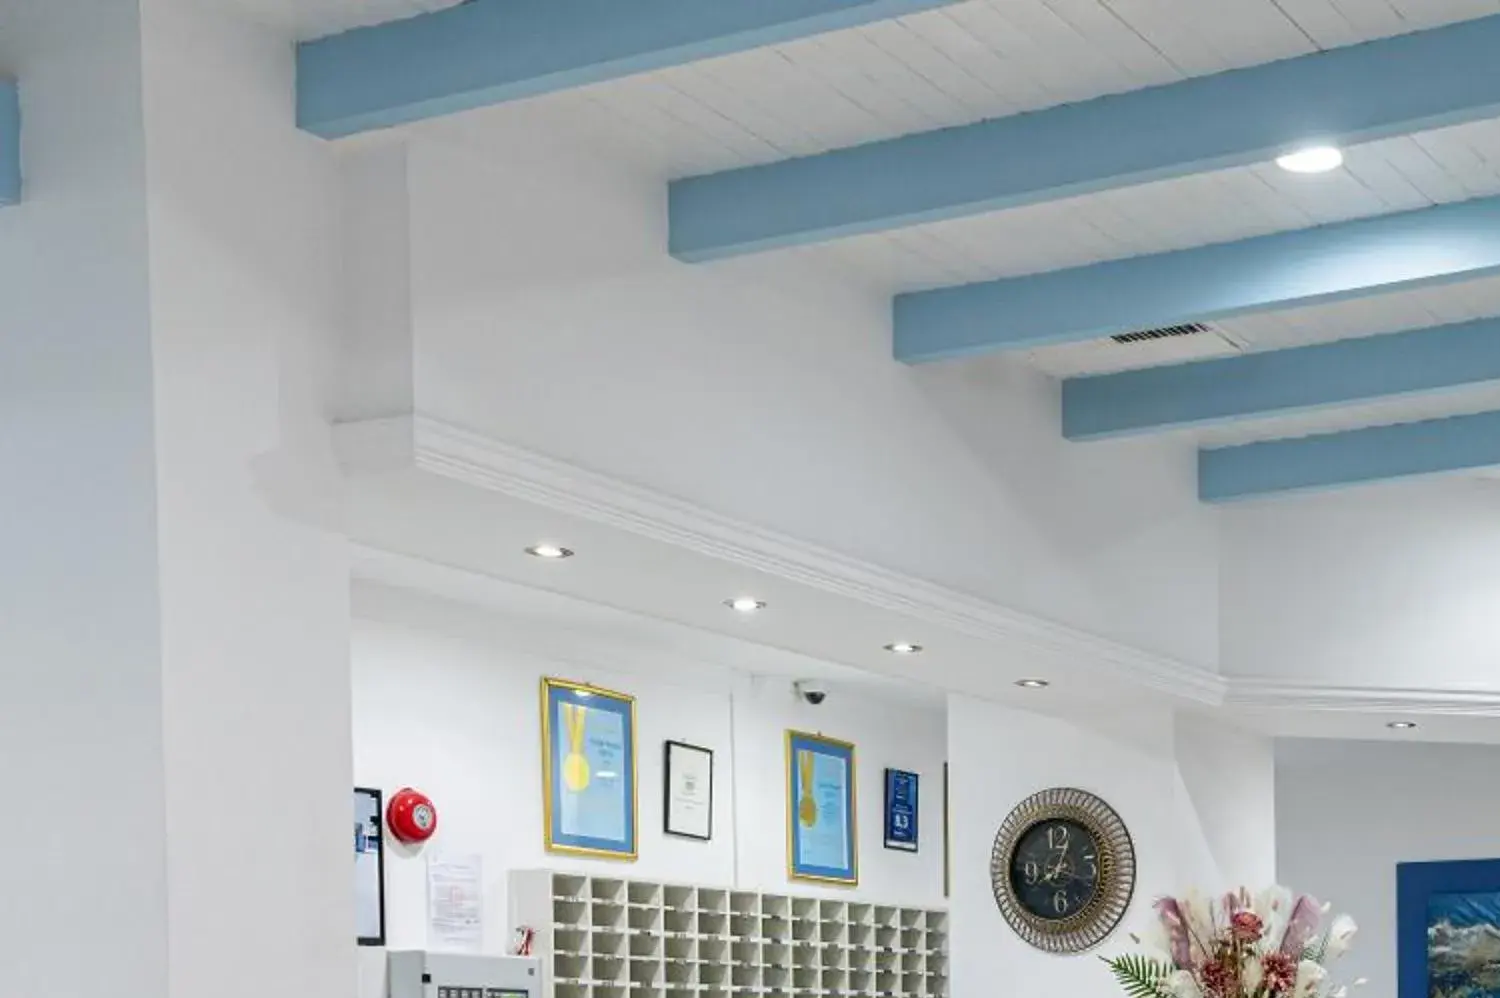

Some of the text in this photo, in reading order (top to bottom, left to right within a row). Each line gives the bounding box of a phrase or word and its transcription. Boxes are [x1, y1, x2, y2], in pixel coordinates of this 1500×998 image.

[1047, 825, 1069, 849] 12
[1024, 861, 1038, 885] 9
[1053, 890, 1069, 913] 6
